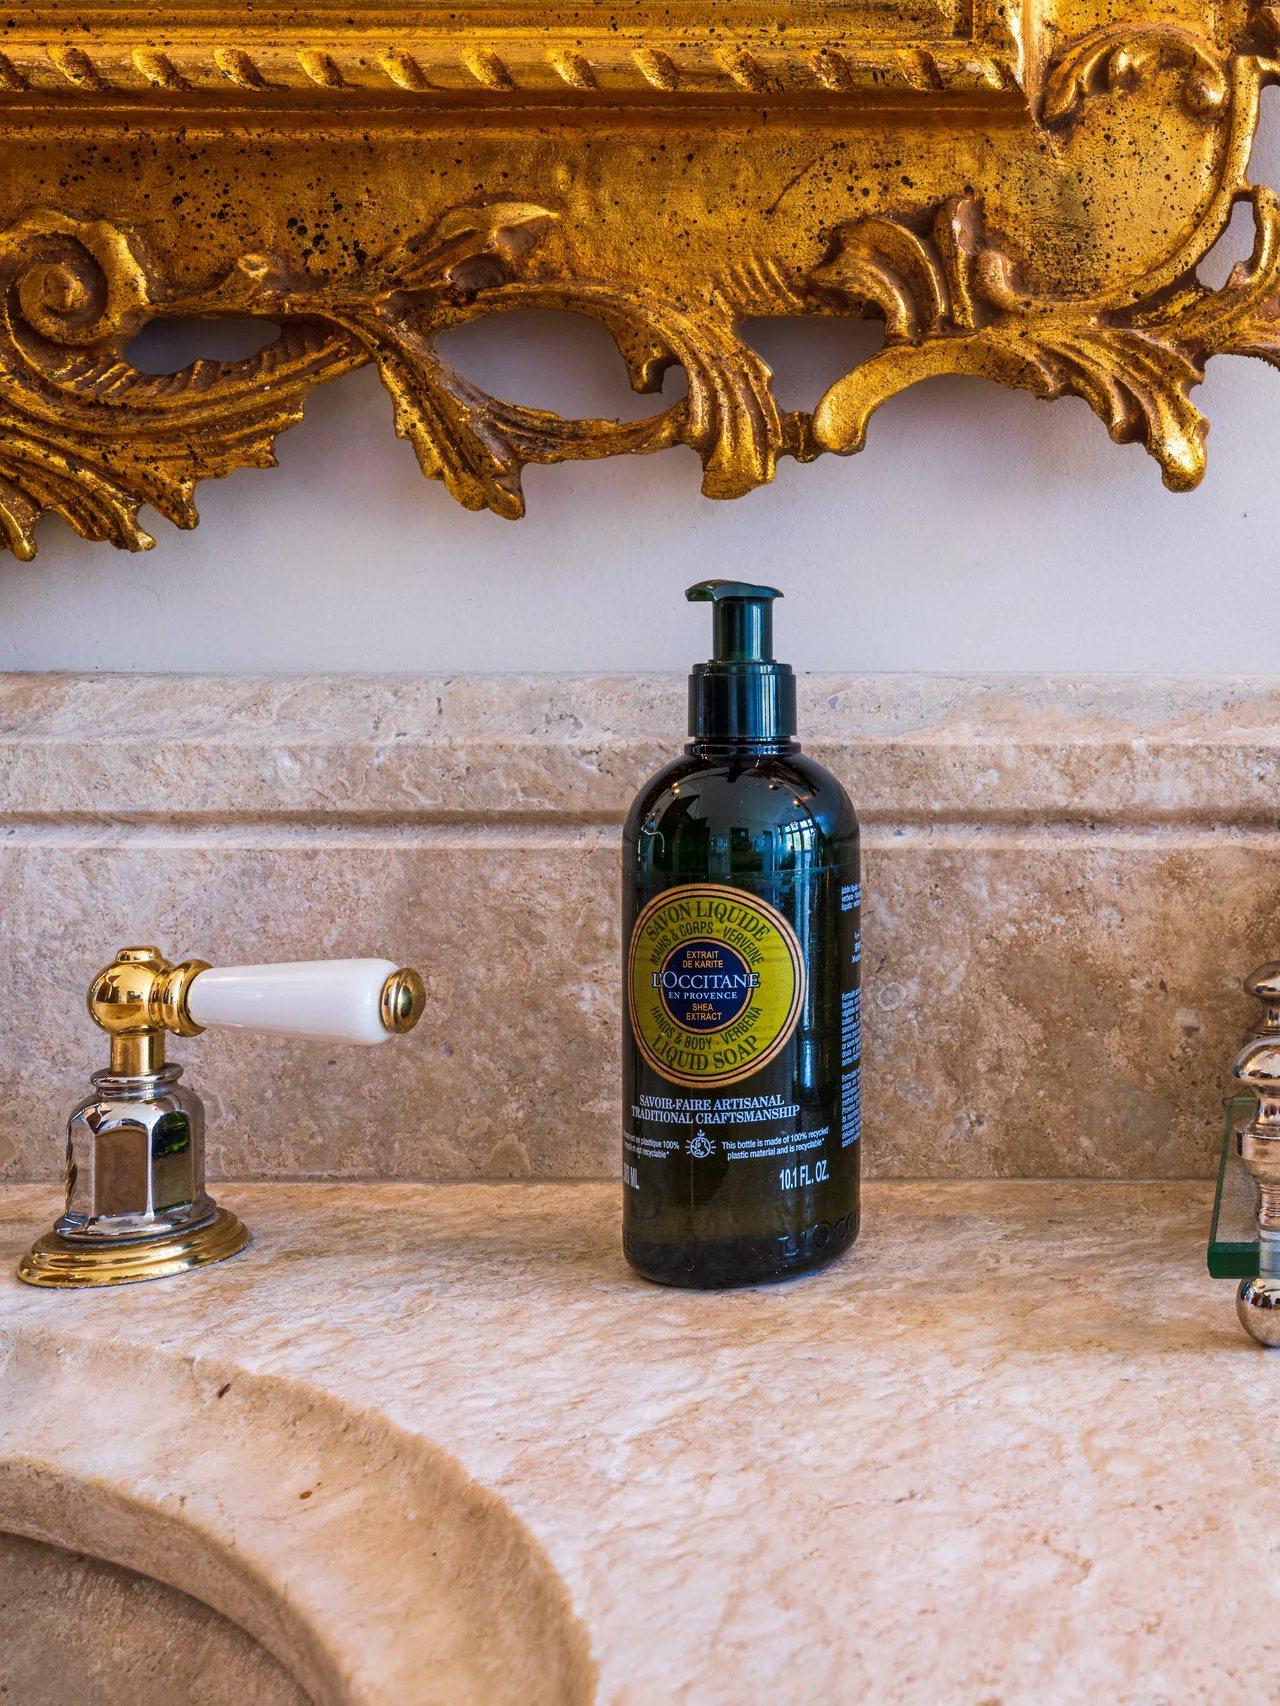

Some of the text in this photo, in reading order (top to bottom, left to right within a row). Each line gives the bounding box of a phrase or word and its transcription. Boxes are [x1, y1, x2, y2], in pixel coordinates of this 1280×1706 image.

[646, 900, 771, 942] SAVON LIQUIDE
[649, 921, 764, 966] MAINS & CORPS VERVEINE
[686, 951, 719, 959] EXTRAIT
[682, 960, 723, 968] DE KARITE
[652, 971, 760, 989] L'OCCITANE
[684, 991, 738, 999] PROVENCE
[692, 1003, 714, 1011] SHEA
[686, 1012, 722, 1021] EXTRACT
[651, 1006, 763, 1050] HANDS & BODY VERBENA
[651, 1034, 759, 1071] LIQUID SOAP
[640, 1094, 785, 1111] SAVOIR-FAIRE ARTISANAL
[631, 1104, 800, 1124] TRADITIONAL CRAFTSMANSHIP
[663, 1141, 680, 1150] 100%
[722, 1141, 736, 1150] This
[737, 1139, 756, 1149] bottle
[757, 1138, 763, 1147] is
[764, 1137, 782, 1146] made
[783, 1135, 790, 1144] of
[791, 1132, 807, 1143] 100%
[727, 1151, 749, 1161] plastic
[750, 1148, 776, 1158] material
[776, 1146, 789, 1155] and
[789, 1144, 795, 1153] is
[780, 1160, 830, 1190] 10.1 FL. OZ.
